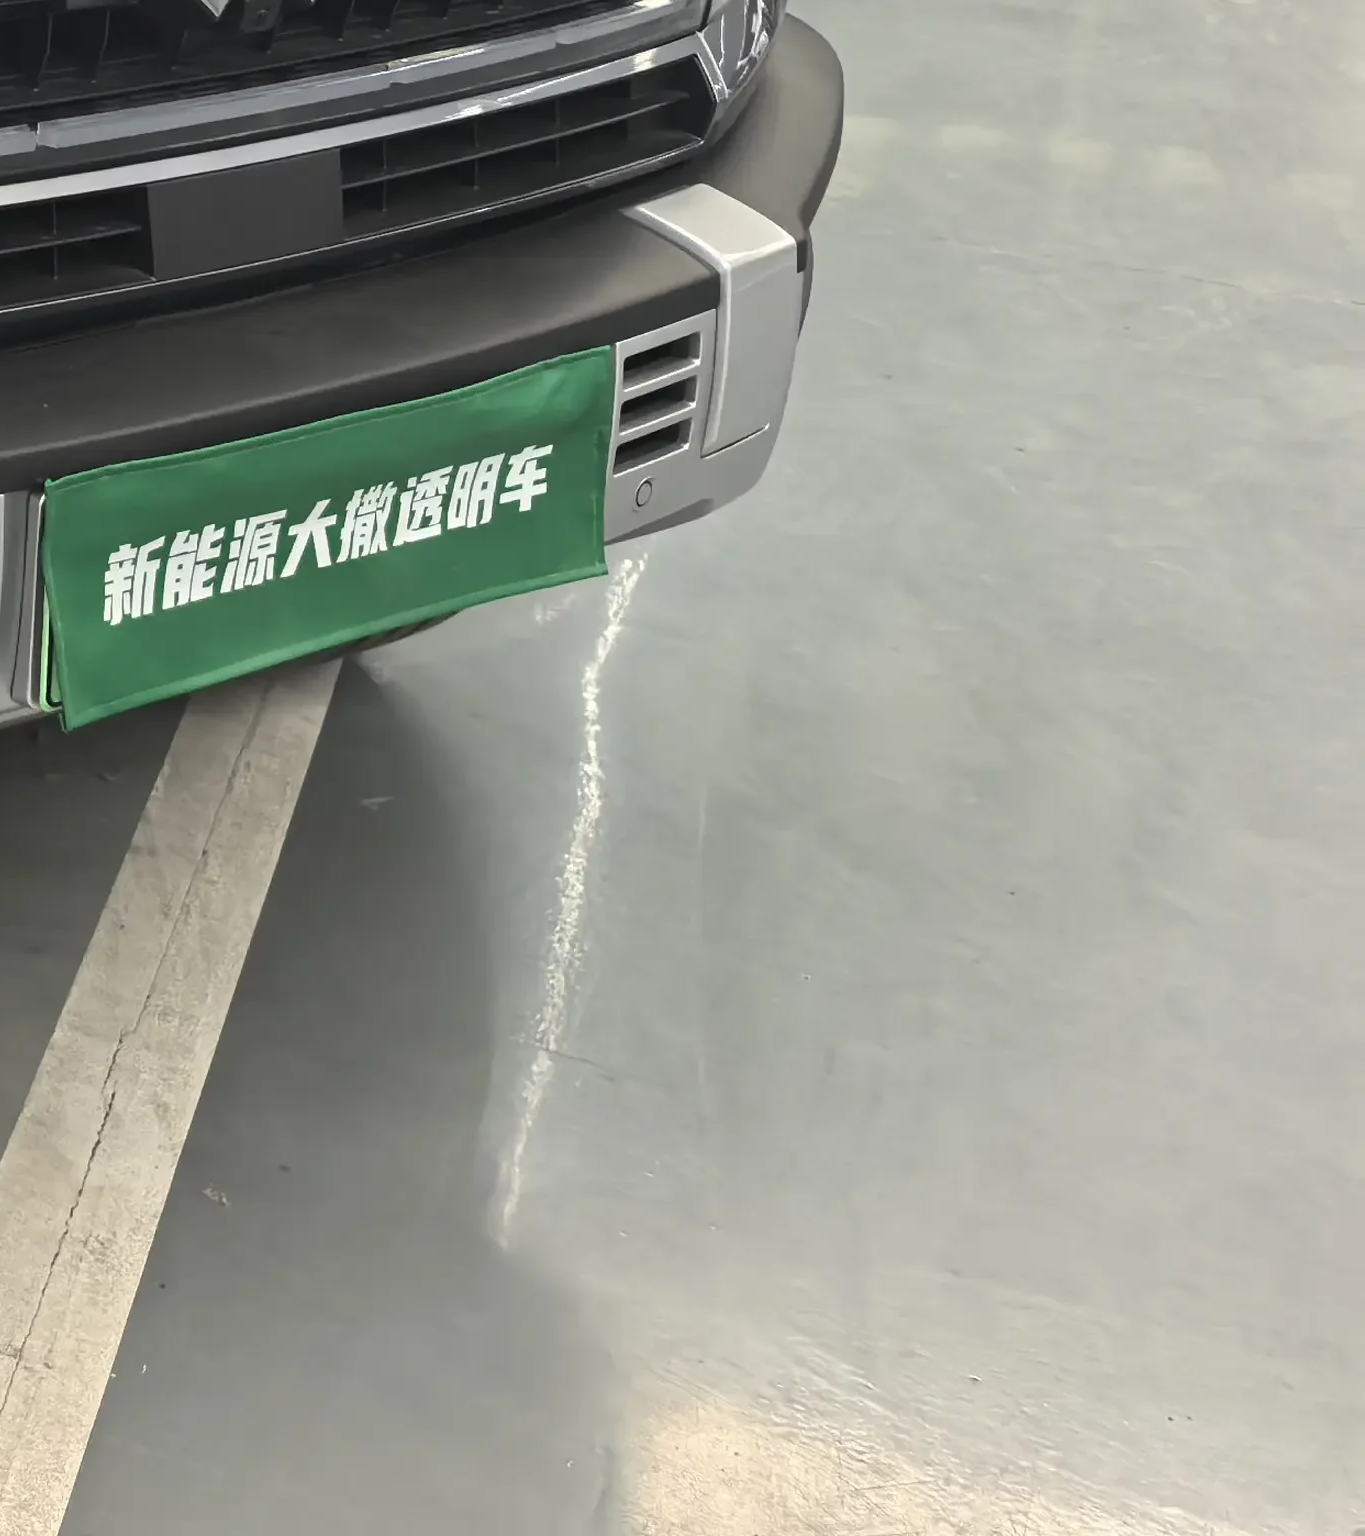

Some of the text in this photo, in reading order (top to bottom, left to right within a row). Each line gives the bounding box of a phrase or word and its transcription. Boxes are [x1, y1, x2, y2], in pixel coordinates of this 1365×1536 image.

[103, 444, 554, 626] 新能源大撒透明车
